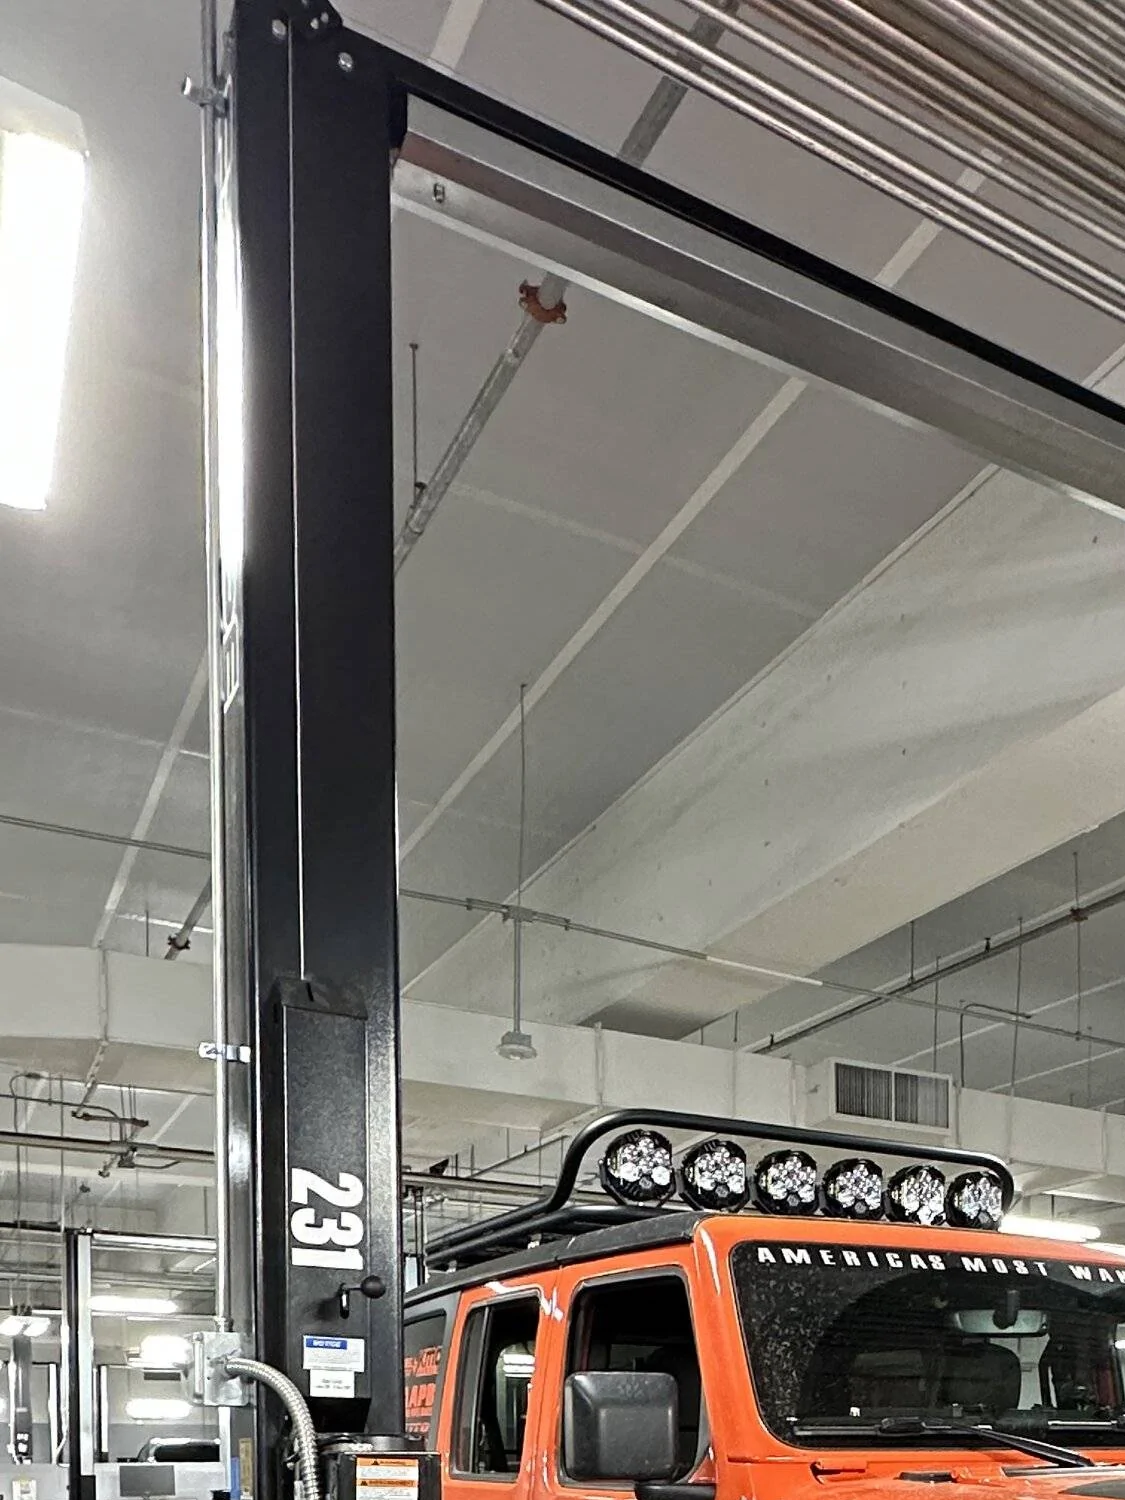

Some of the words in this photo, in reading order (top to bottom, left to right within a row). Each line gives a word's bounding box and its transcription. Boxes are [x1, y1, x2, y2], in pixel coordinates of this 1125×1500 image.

[290, 1168, 364, 1271] 231
[756, 1246, 946, 1272] AMERICAS
[962, 1257, 1049, 1277] MOST
